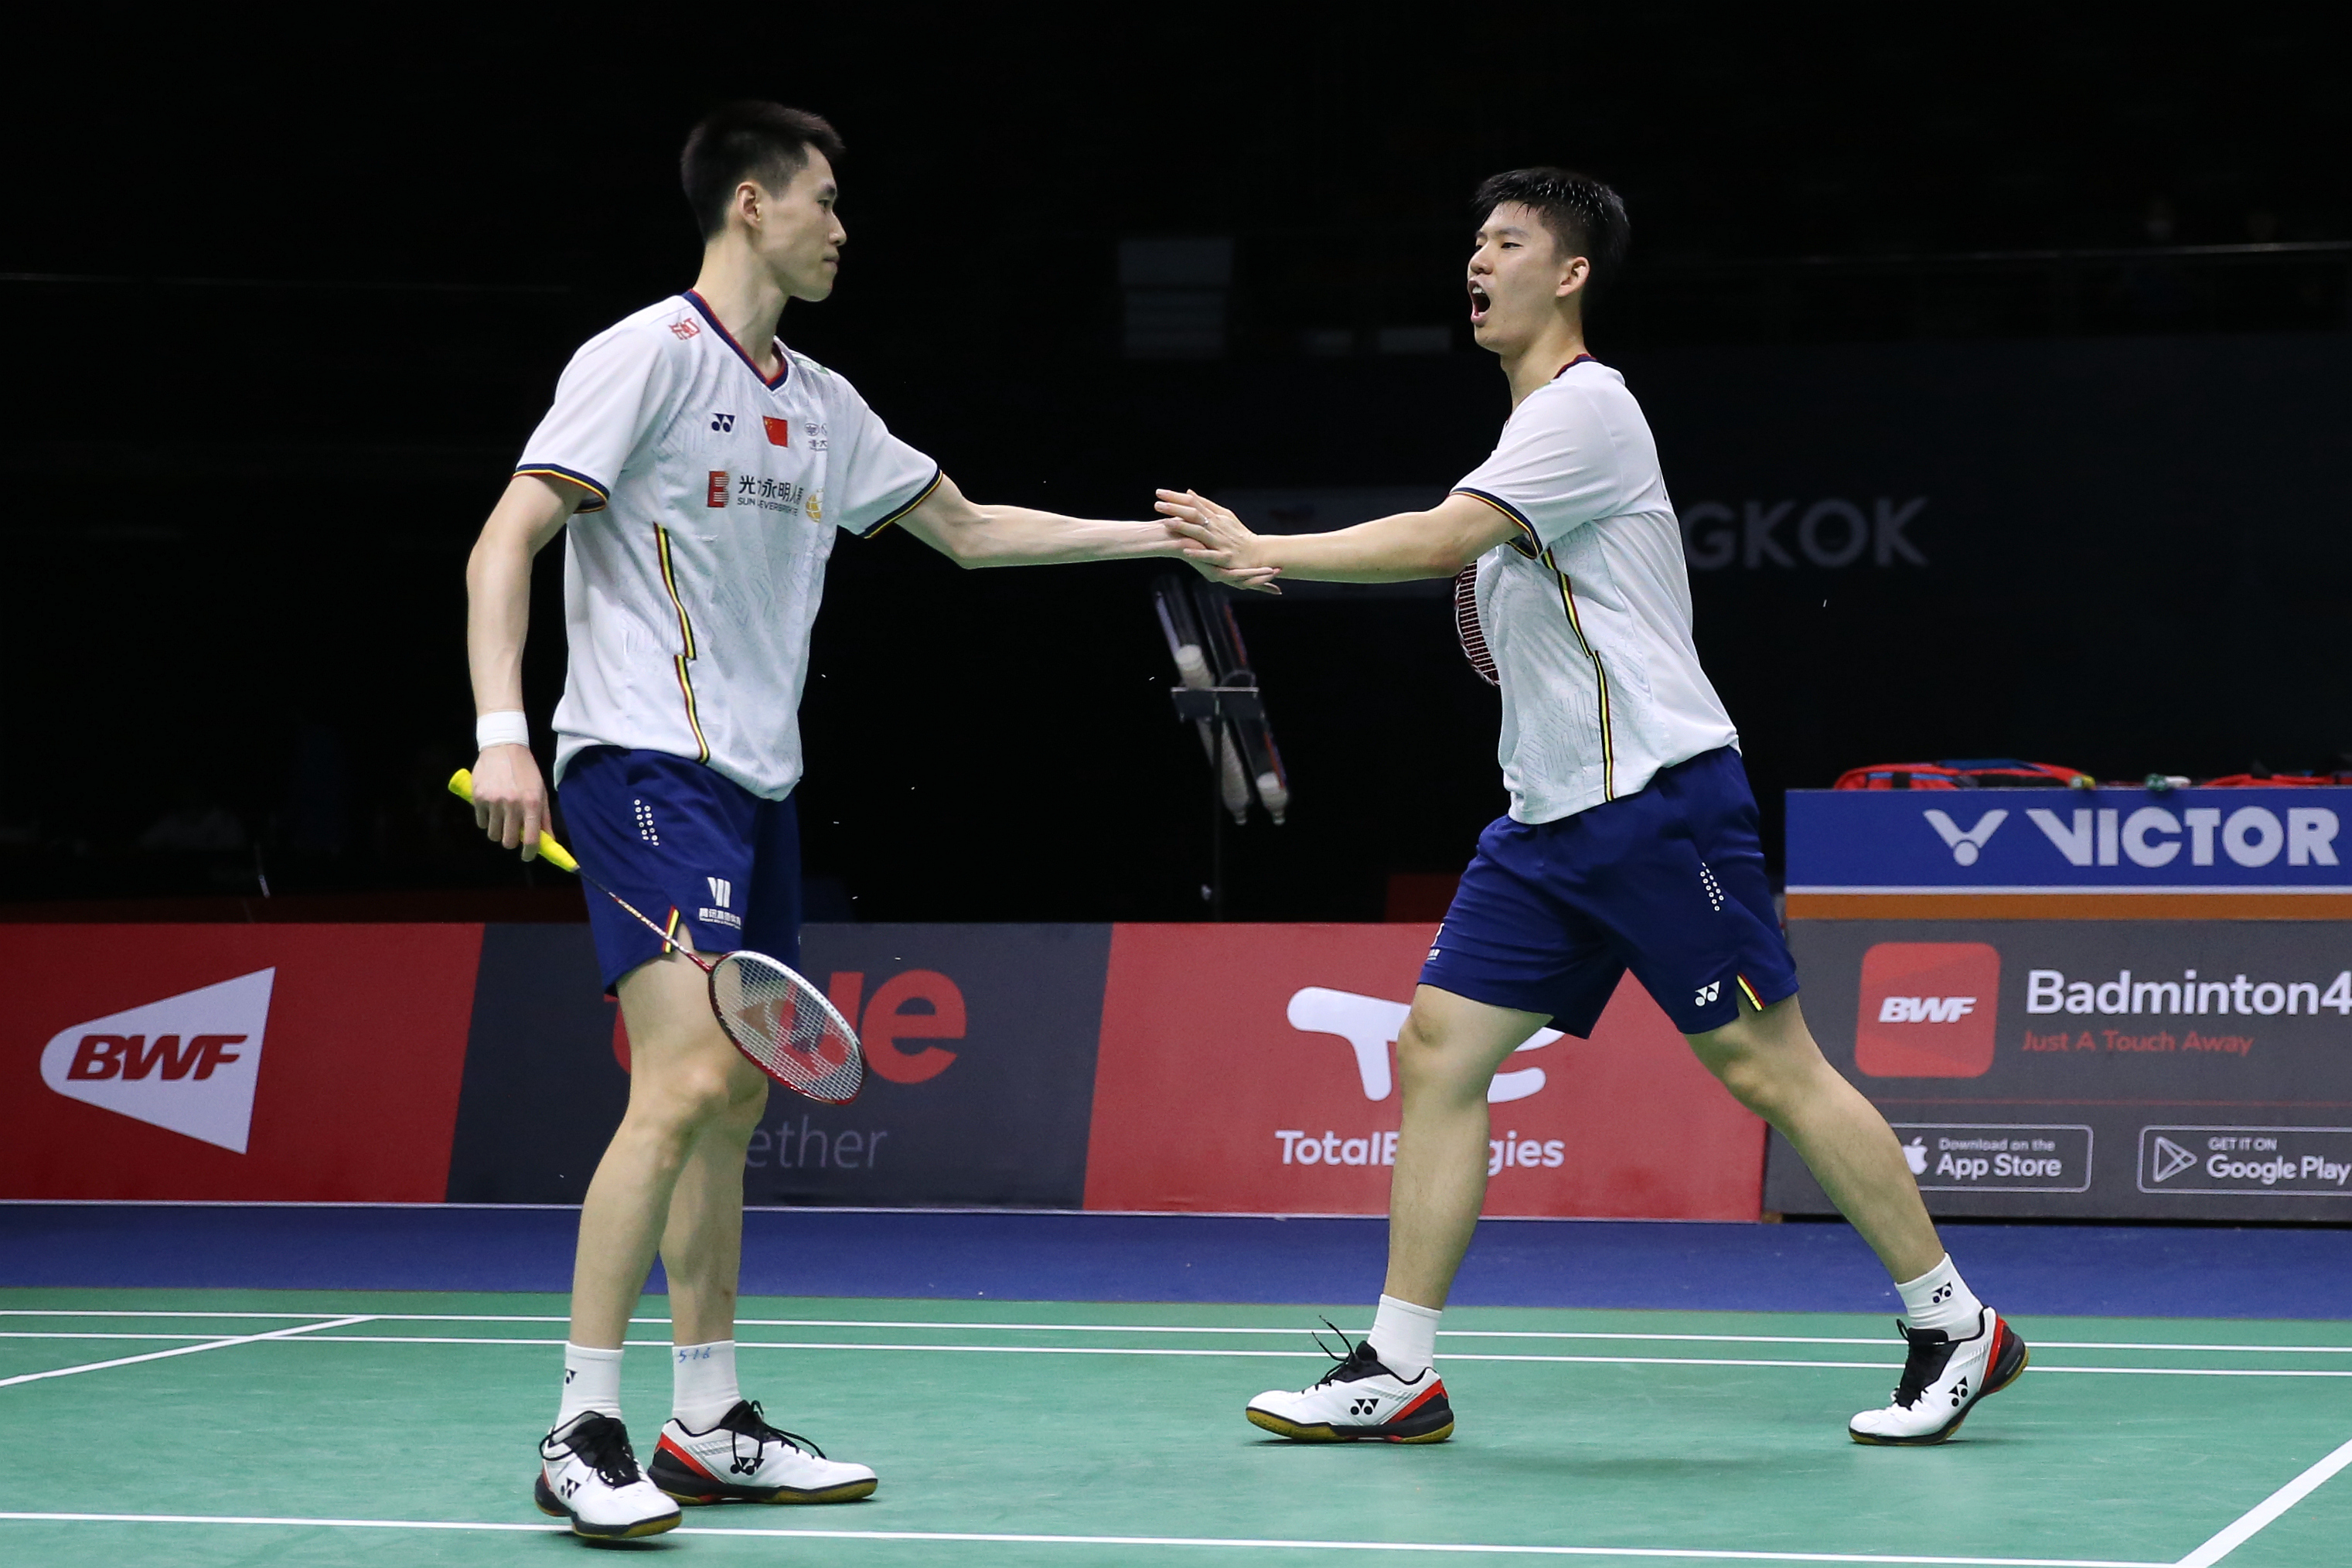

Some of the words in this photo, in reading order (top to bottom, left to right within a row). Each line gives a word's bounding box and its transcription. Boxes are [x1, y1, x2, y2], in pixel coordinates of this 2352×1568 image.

[738, 497, 755, 506] SUN
[1682, 496, 1931, 571] GKOK
[2025, 806, 2340, 868] VICTOR
[2026, 969, 2352, 1014] Badminton4
[1878, 997, 1977, 1023] BWF
[66, 1034, 247, 1080] BWF
[2022, 1029, 2068, 1052] Just
[2075, 1031, 2096, 1052] A
[2101, 1030, 2176, 1052] Touch
[2182, 1031, 2255, 1056] Away
[746, 1114, 888, 1169] ether
[1274, 1130, 1565, 1177] TotalEgies
[1938, 1137, 2008, 1151] Download
[2010, 1140, 2029, 1151] on
[2031, 1139, 2056, 1151] the
[2207, 1137, 2238, 1150] GET
[2238, 1137, 2252, 1150] IT
[2252, 1138, 2277, 1151] ON
[1935, 1152, 1989, 1181] App
[1993, 1153, 2062, 1177] Store
[2206, 1154, 2297, 1185] Google
[2300, 1155, 2351, 1186] Play
